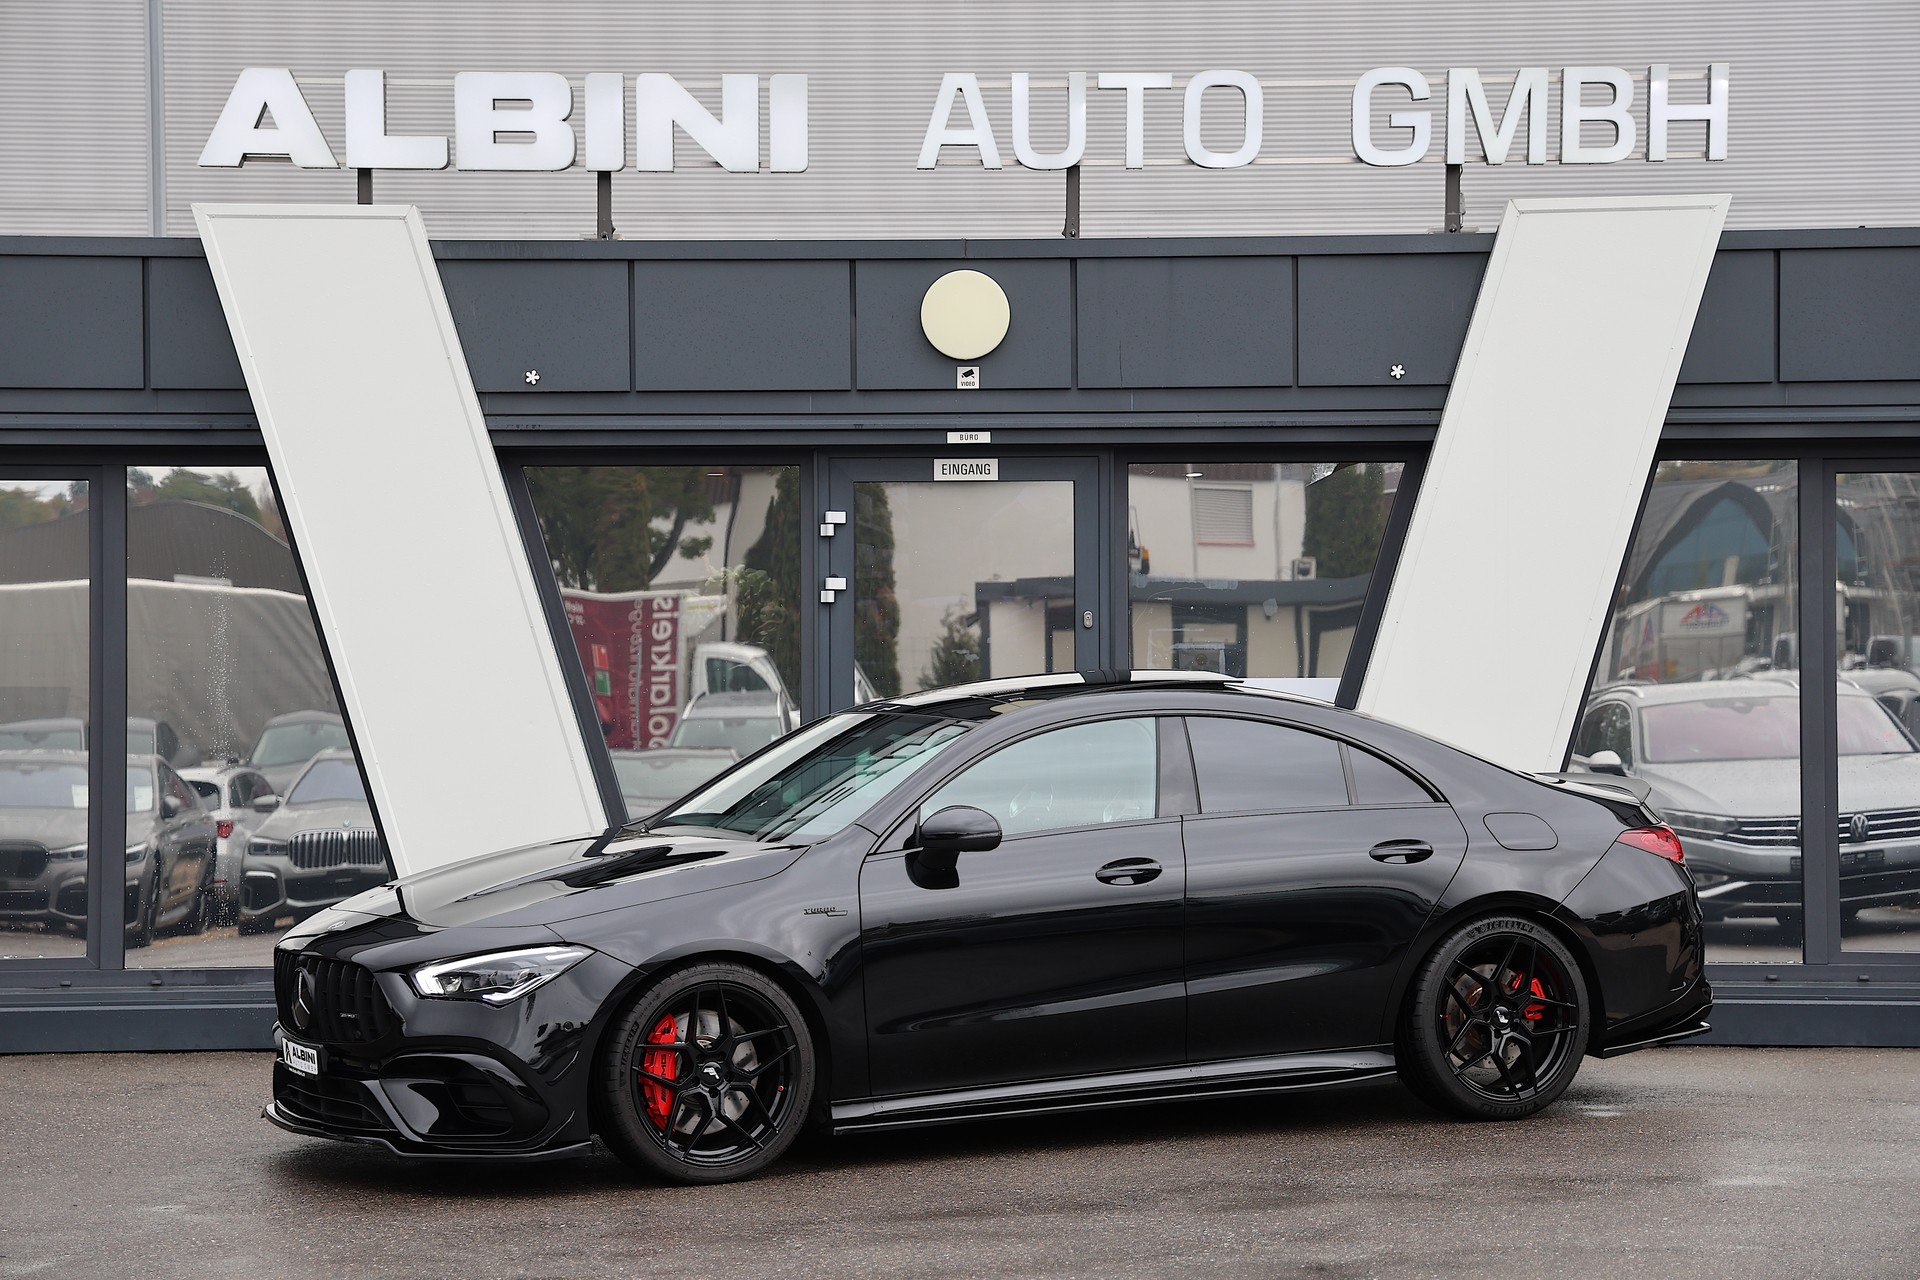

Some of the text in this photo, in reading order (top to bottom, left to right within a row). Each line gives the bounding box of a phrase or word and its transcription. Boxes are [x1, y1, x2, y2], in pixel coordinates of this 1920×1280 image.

[198, 63, 1730, 173] ALBINI AUTO GMBH
[959, 432, 979, 441] BÜRO
[941, 463, 991, 475] EINGANG
[1474, 919, 1535, 935] MICHELIN
[292, 1045, 316, 1065] ALBINI
